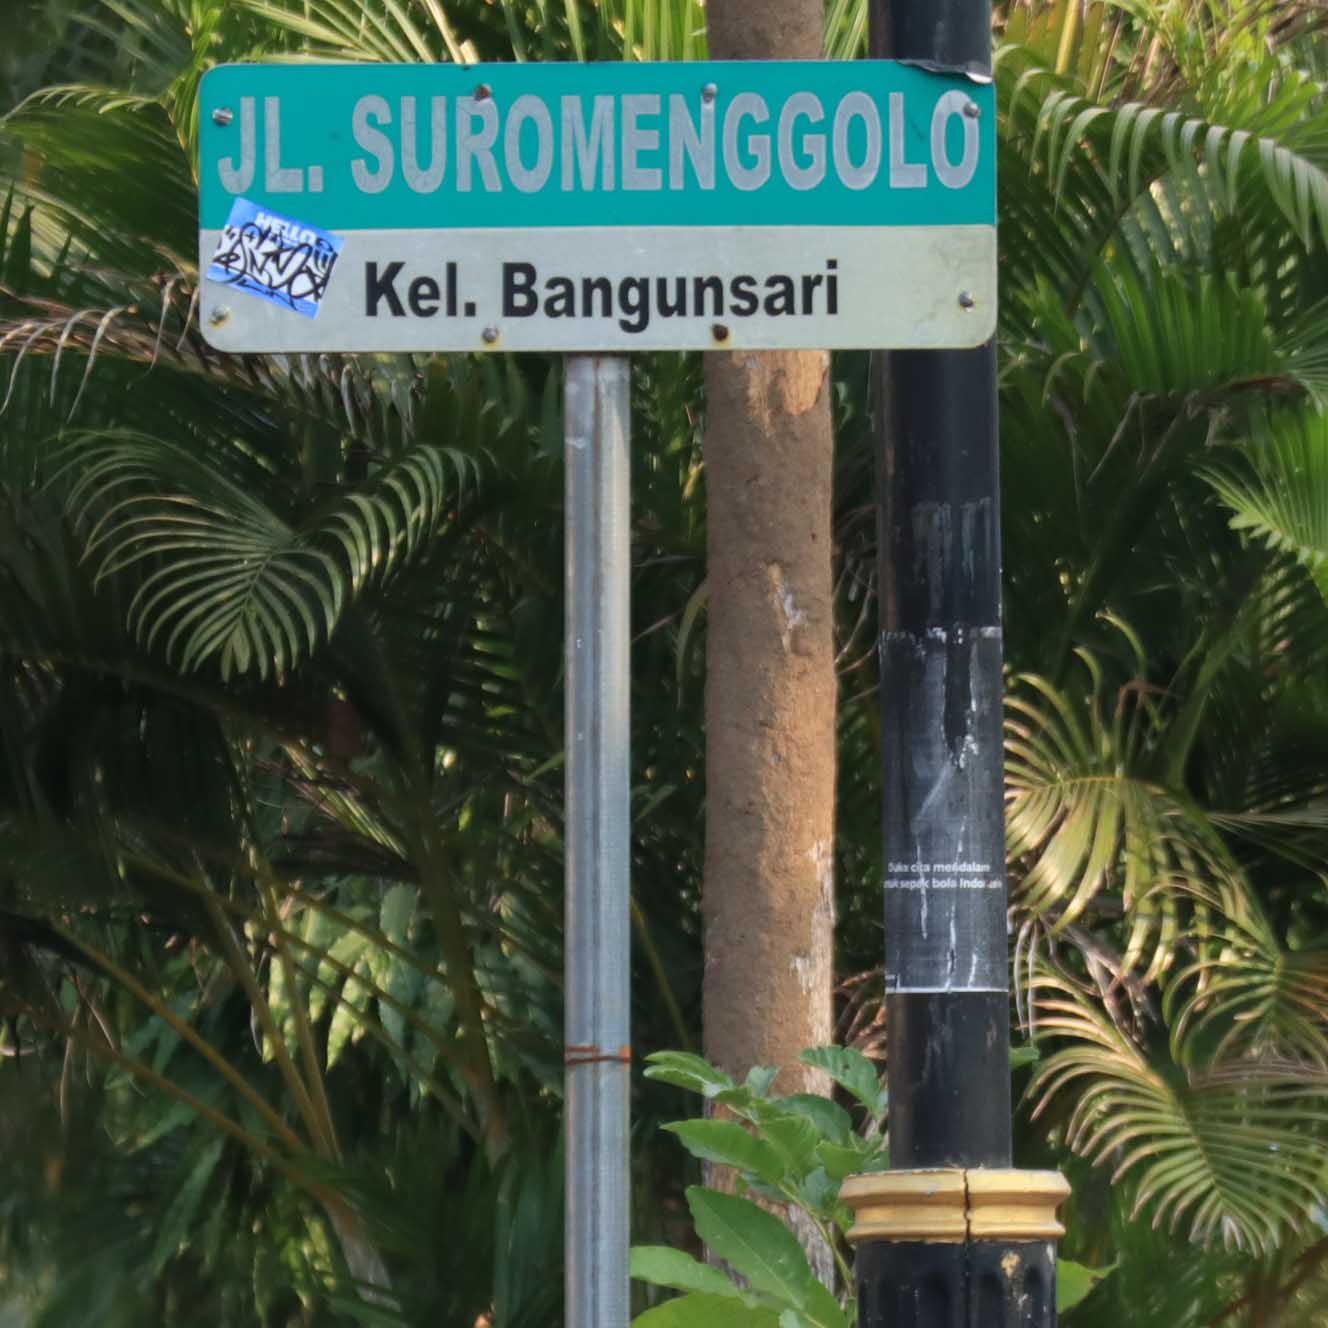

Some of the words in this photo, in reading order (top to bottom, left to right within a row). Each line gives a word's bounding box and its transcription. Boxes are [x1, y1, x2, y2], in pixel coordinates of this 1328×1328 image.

[217, 95, 323, 192] JL.
[351, 90, 979, 192] SUROMENGGOLO
[364, 261, 476, 318] Kel.
[501, 259, 838, 332] Bangunsari
